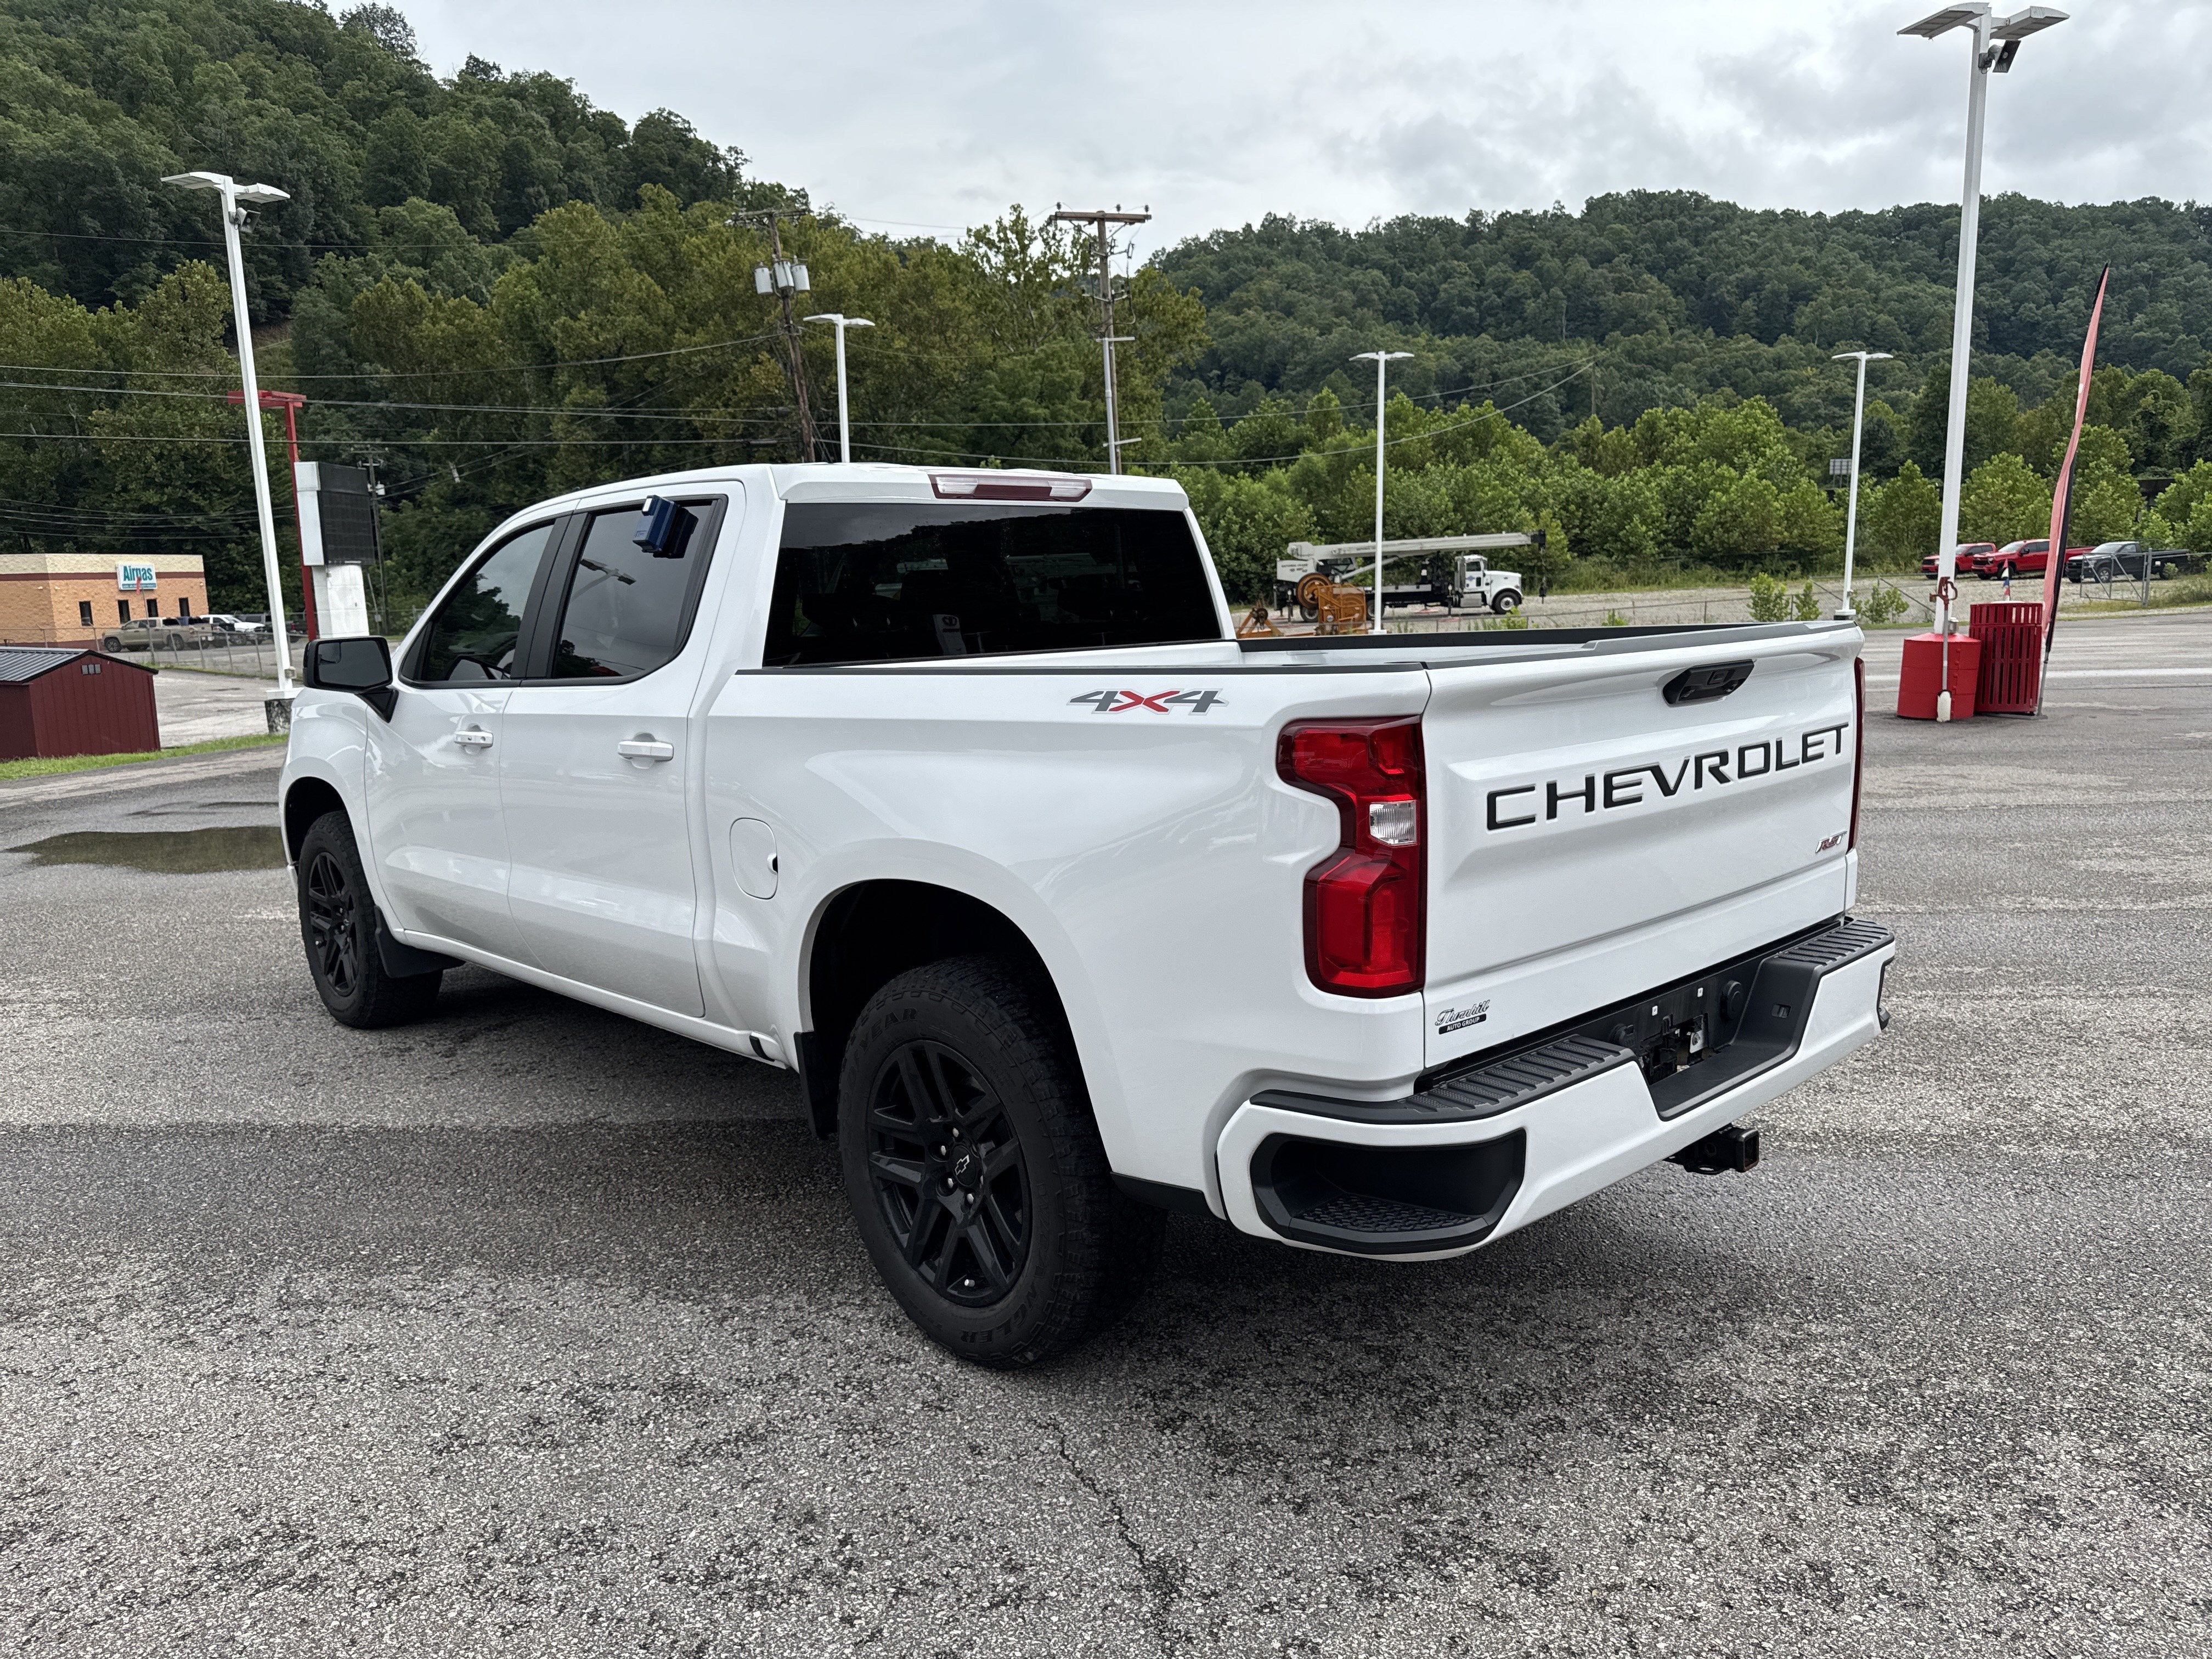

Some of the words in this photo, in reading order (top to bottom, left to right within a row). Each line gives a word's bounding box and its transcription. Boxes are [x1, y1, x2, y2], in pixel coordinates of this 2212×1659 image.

[1486, 721, 1849, 831] CHEVROLET
[1815, 831, 1847, 853] RST
[1435, 1000, 1491, 1026] Thornhill
[1447, 1022, 1461, 1031] AUTO
[1462, 1017, 1480, 1027] GROUP
